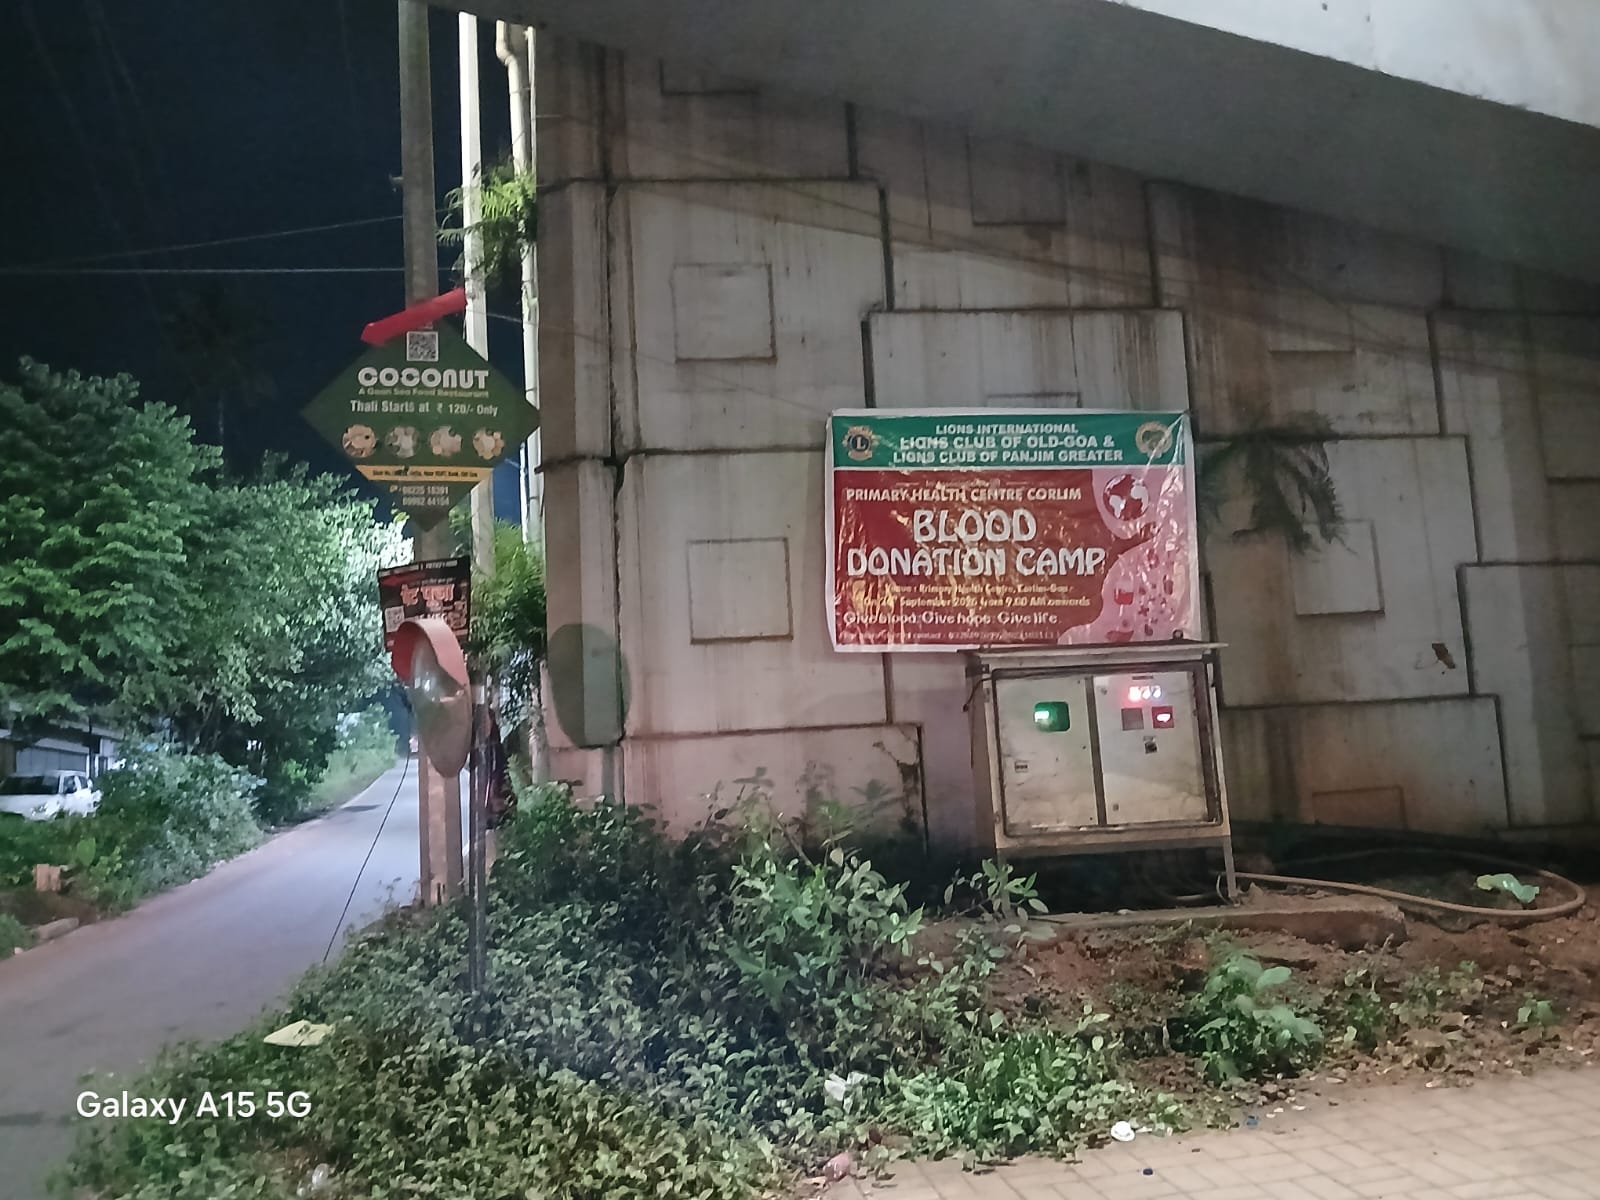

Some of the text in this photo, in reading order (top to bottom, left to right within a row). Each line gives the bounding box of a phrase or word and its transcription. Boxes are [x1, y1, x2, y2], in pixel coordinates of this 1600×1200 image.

[358, 367, 489, 389] COCONUT
[350, 400, 378, 413] Thali
[381, 401, 415, 413] Starts
[418, 401, 430, 413] at
[476, 404, 499, 417] Only
[936, 423, 1079, 435] LIONS INTERNATIONAL
[953, 436, 997, 449] CLUB
[1001, 436, 1023, 449] OF
[1103, 435, 1115, 448] &
[893, 449, 1123, 464] LIONS CLUB OF PANJIM GREATER
[845, 487, 1082, 502] PRIMARY HEALTH CENTRE CORLIM
[913, 508, 1038, 543] BLOOD
[847, 547, 1107, 577] DONATION CAMP
[921, 610, 955, 624] Give
[997, 610, 1032, 625] Give
